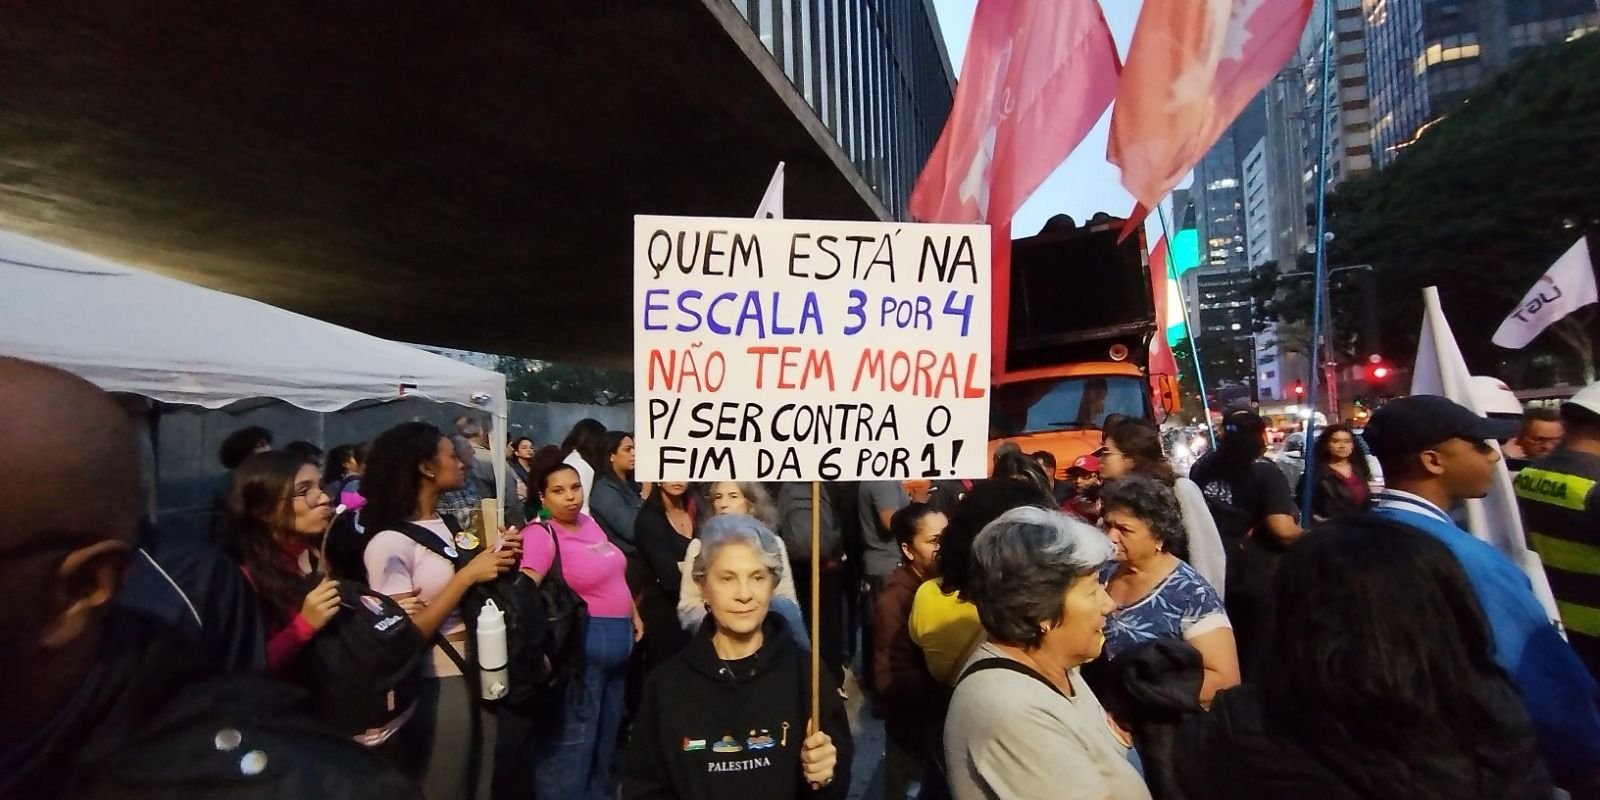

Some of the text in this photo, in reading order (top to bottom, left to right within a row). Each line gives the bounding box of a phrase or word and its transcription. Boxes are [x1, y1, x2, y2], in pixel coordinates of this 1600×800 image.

[647, 228, 978, 284] QUEM ESTÁ NA
[643, 288, 974, 339] ESCALA 3 POR 4
[648, 341, 986, 399] NÃO TEM MORAL
[687, 401, 764, 443] SER
[770, 403, 899, 445] CONTRA
[926, 404, 952, 438] O
[659, 446, 737, 481] FIM
[756, 446, 802, 481] DA
[817, 446, 842, 481] 6
[856, 447, 910, 480] POR
[707, 757, 771, 772] PALESTINA
